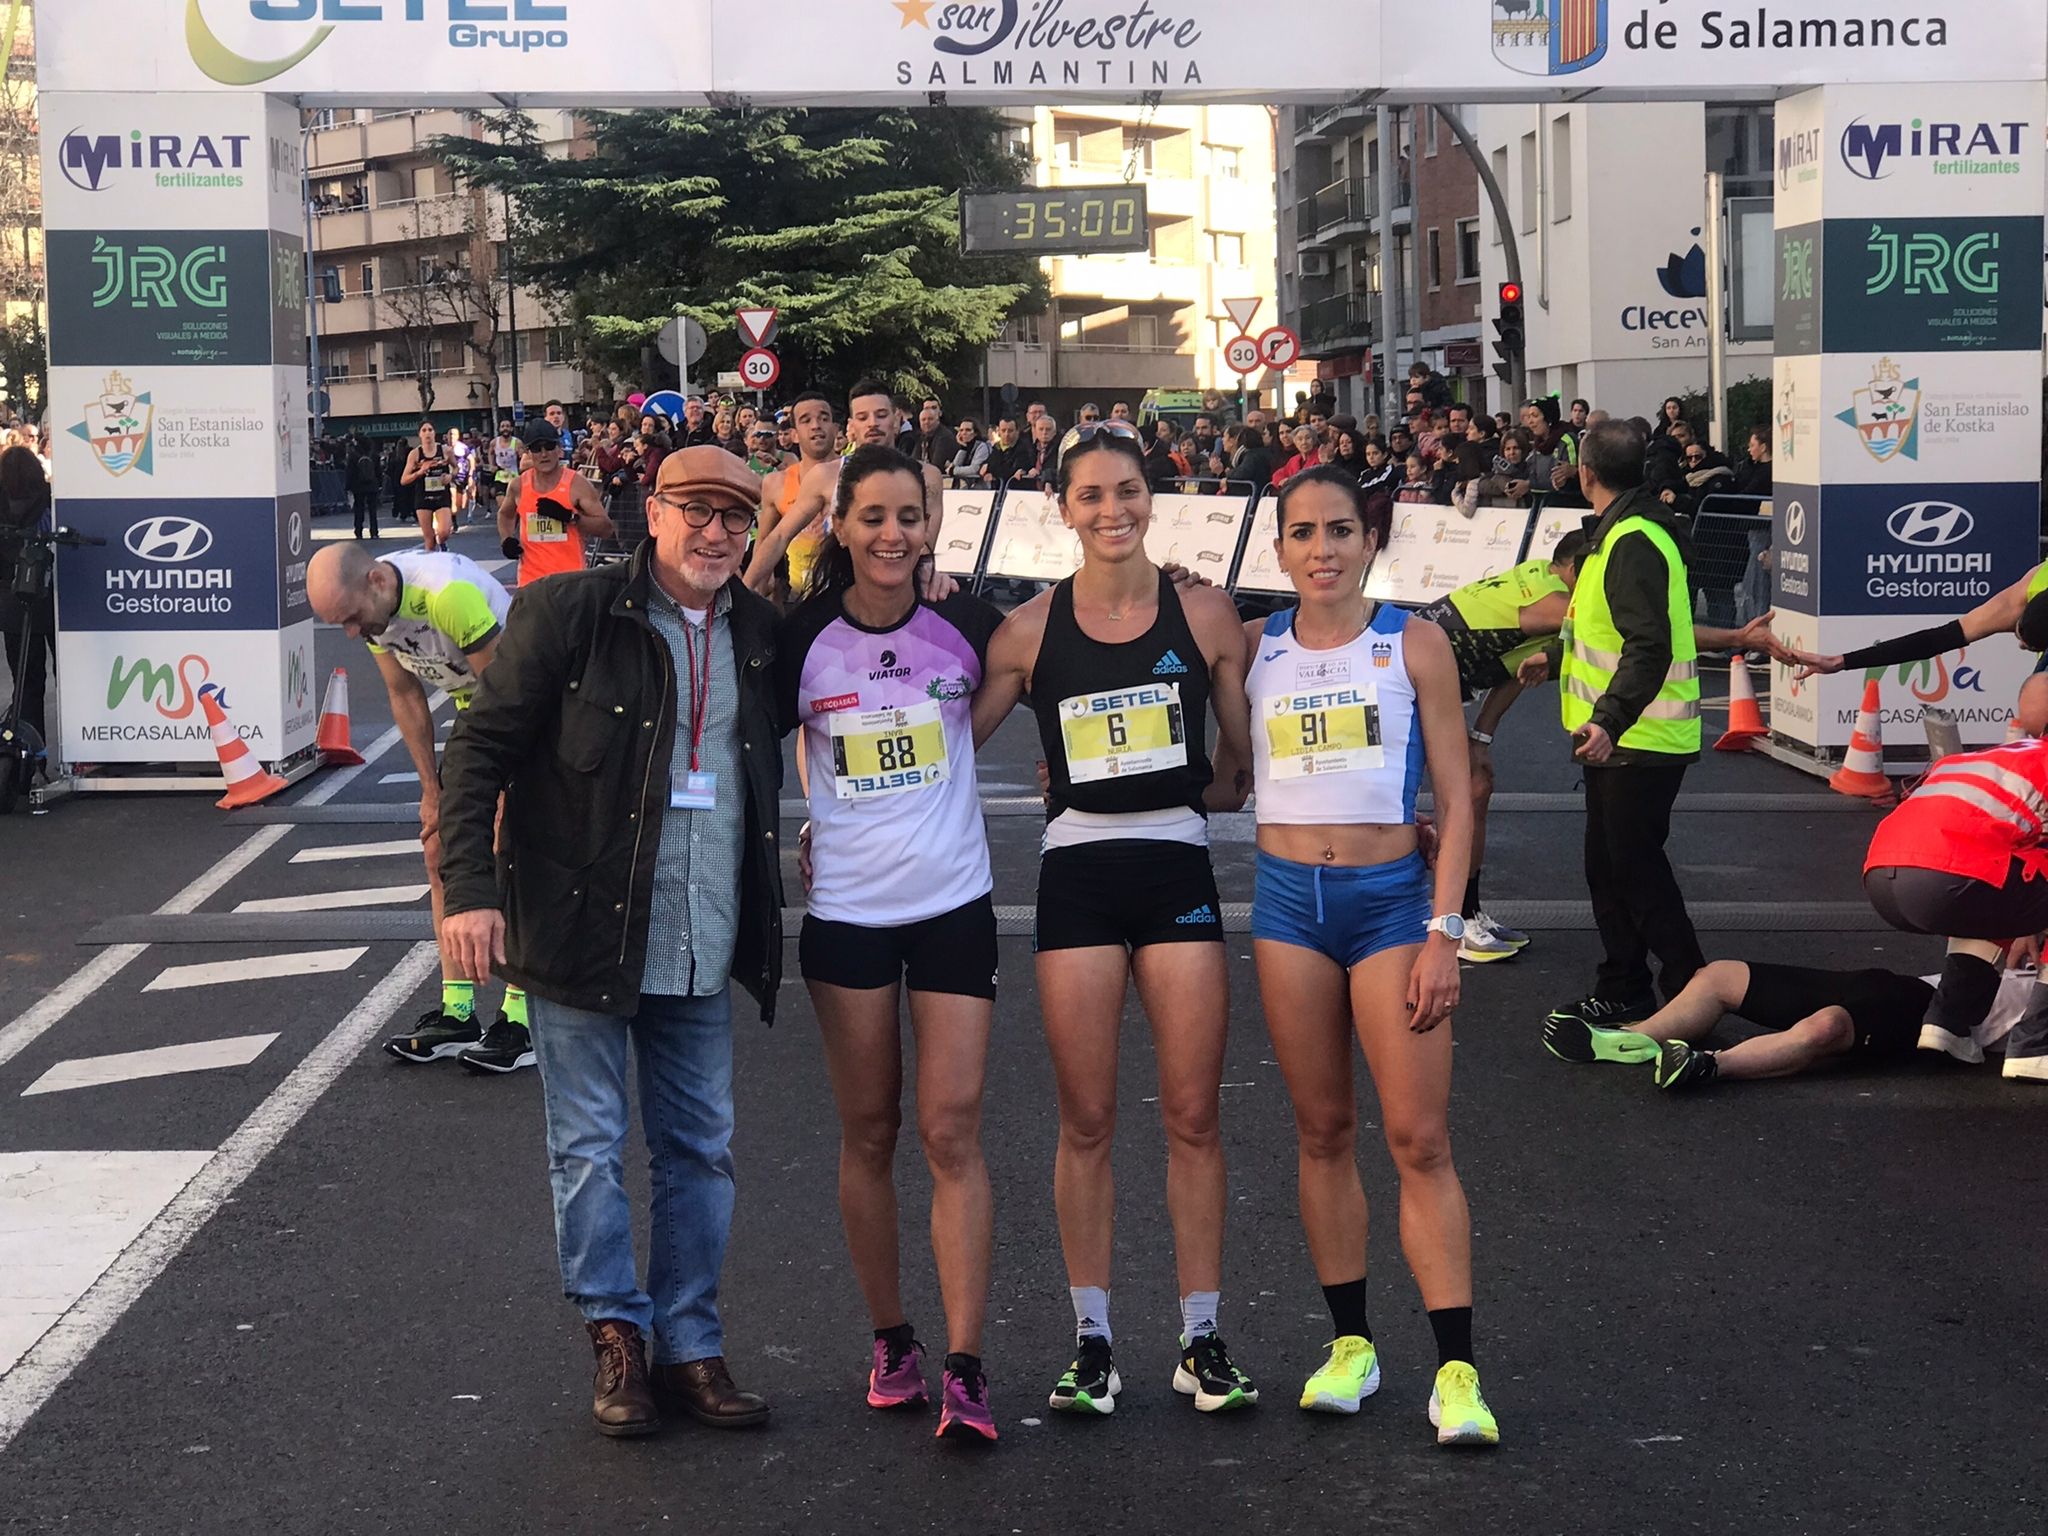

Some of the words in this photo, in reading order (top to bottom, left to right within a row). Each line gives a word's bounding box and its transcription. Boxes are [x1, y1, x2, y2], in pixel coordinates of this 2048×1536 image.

[448, 23, 568, 53] Grupo
[1624, 10, 1678, 50] de
[1701, 9, 1948, 50] Salamanca
[896, 60, 1202, 85] SALMANTINA
[1933, 159, 2020, 175] fertilizantes
[155, 172, 244, 188] fertilizantes
[1866, 227, 1999, 295] JRG
[92, 238, 227, 308] JRG
[1621, 306, 1709, 331] CleceV
[1651, 335, 1680, 349] San
[1233, 348, 1255, 362] 30
[748, 362, 770, 375] 30
[1924, 402, 1954, 418] San
[1955, 401, 2029, 418] Estanislao
[158, 417, 187, 432] San
[189, 416, 264, 432] Estanislao
[1924, 419, 1942, 433] de
[1945, 419, 1995, 433] Kostka
[158, 433, 176, 448] de
[179, 433, 231, 448] Kostka
[536, 520, 553, 533] 104
[1867, 553, 1992, 574] HYUNDAI
[106, 569, 232, 589] HYUNDAI
[1867, 578, 1991, 598] Gestorauto
[106, 593, 232, 614] Gestorauto
[868, 667, 912, 681] VIATOR
[1152, 663, 1188, 675] adidas
[1091, 689, 1169, 713] SETEL
[1292, 689, 1366, 711] SETEL
[1107, 712, 1128, 747] 6
[1300, 711, 1328, 746] 91
[876, 735, 917, 772] 88
[1291, 746, 1315, 756] LIDIA
[1318, 743, 1343, 753] CAMPO
[847, 770, 922, 793] SETEL
[1175, 911, 1217, 925] adidas
